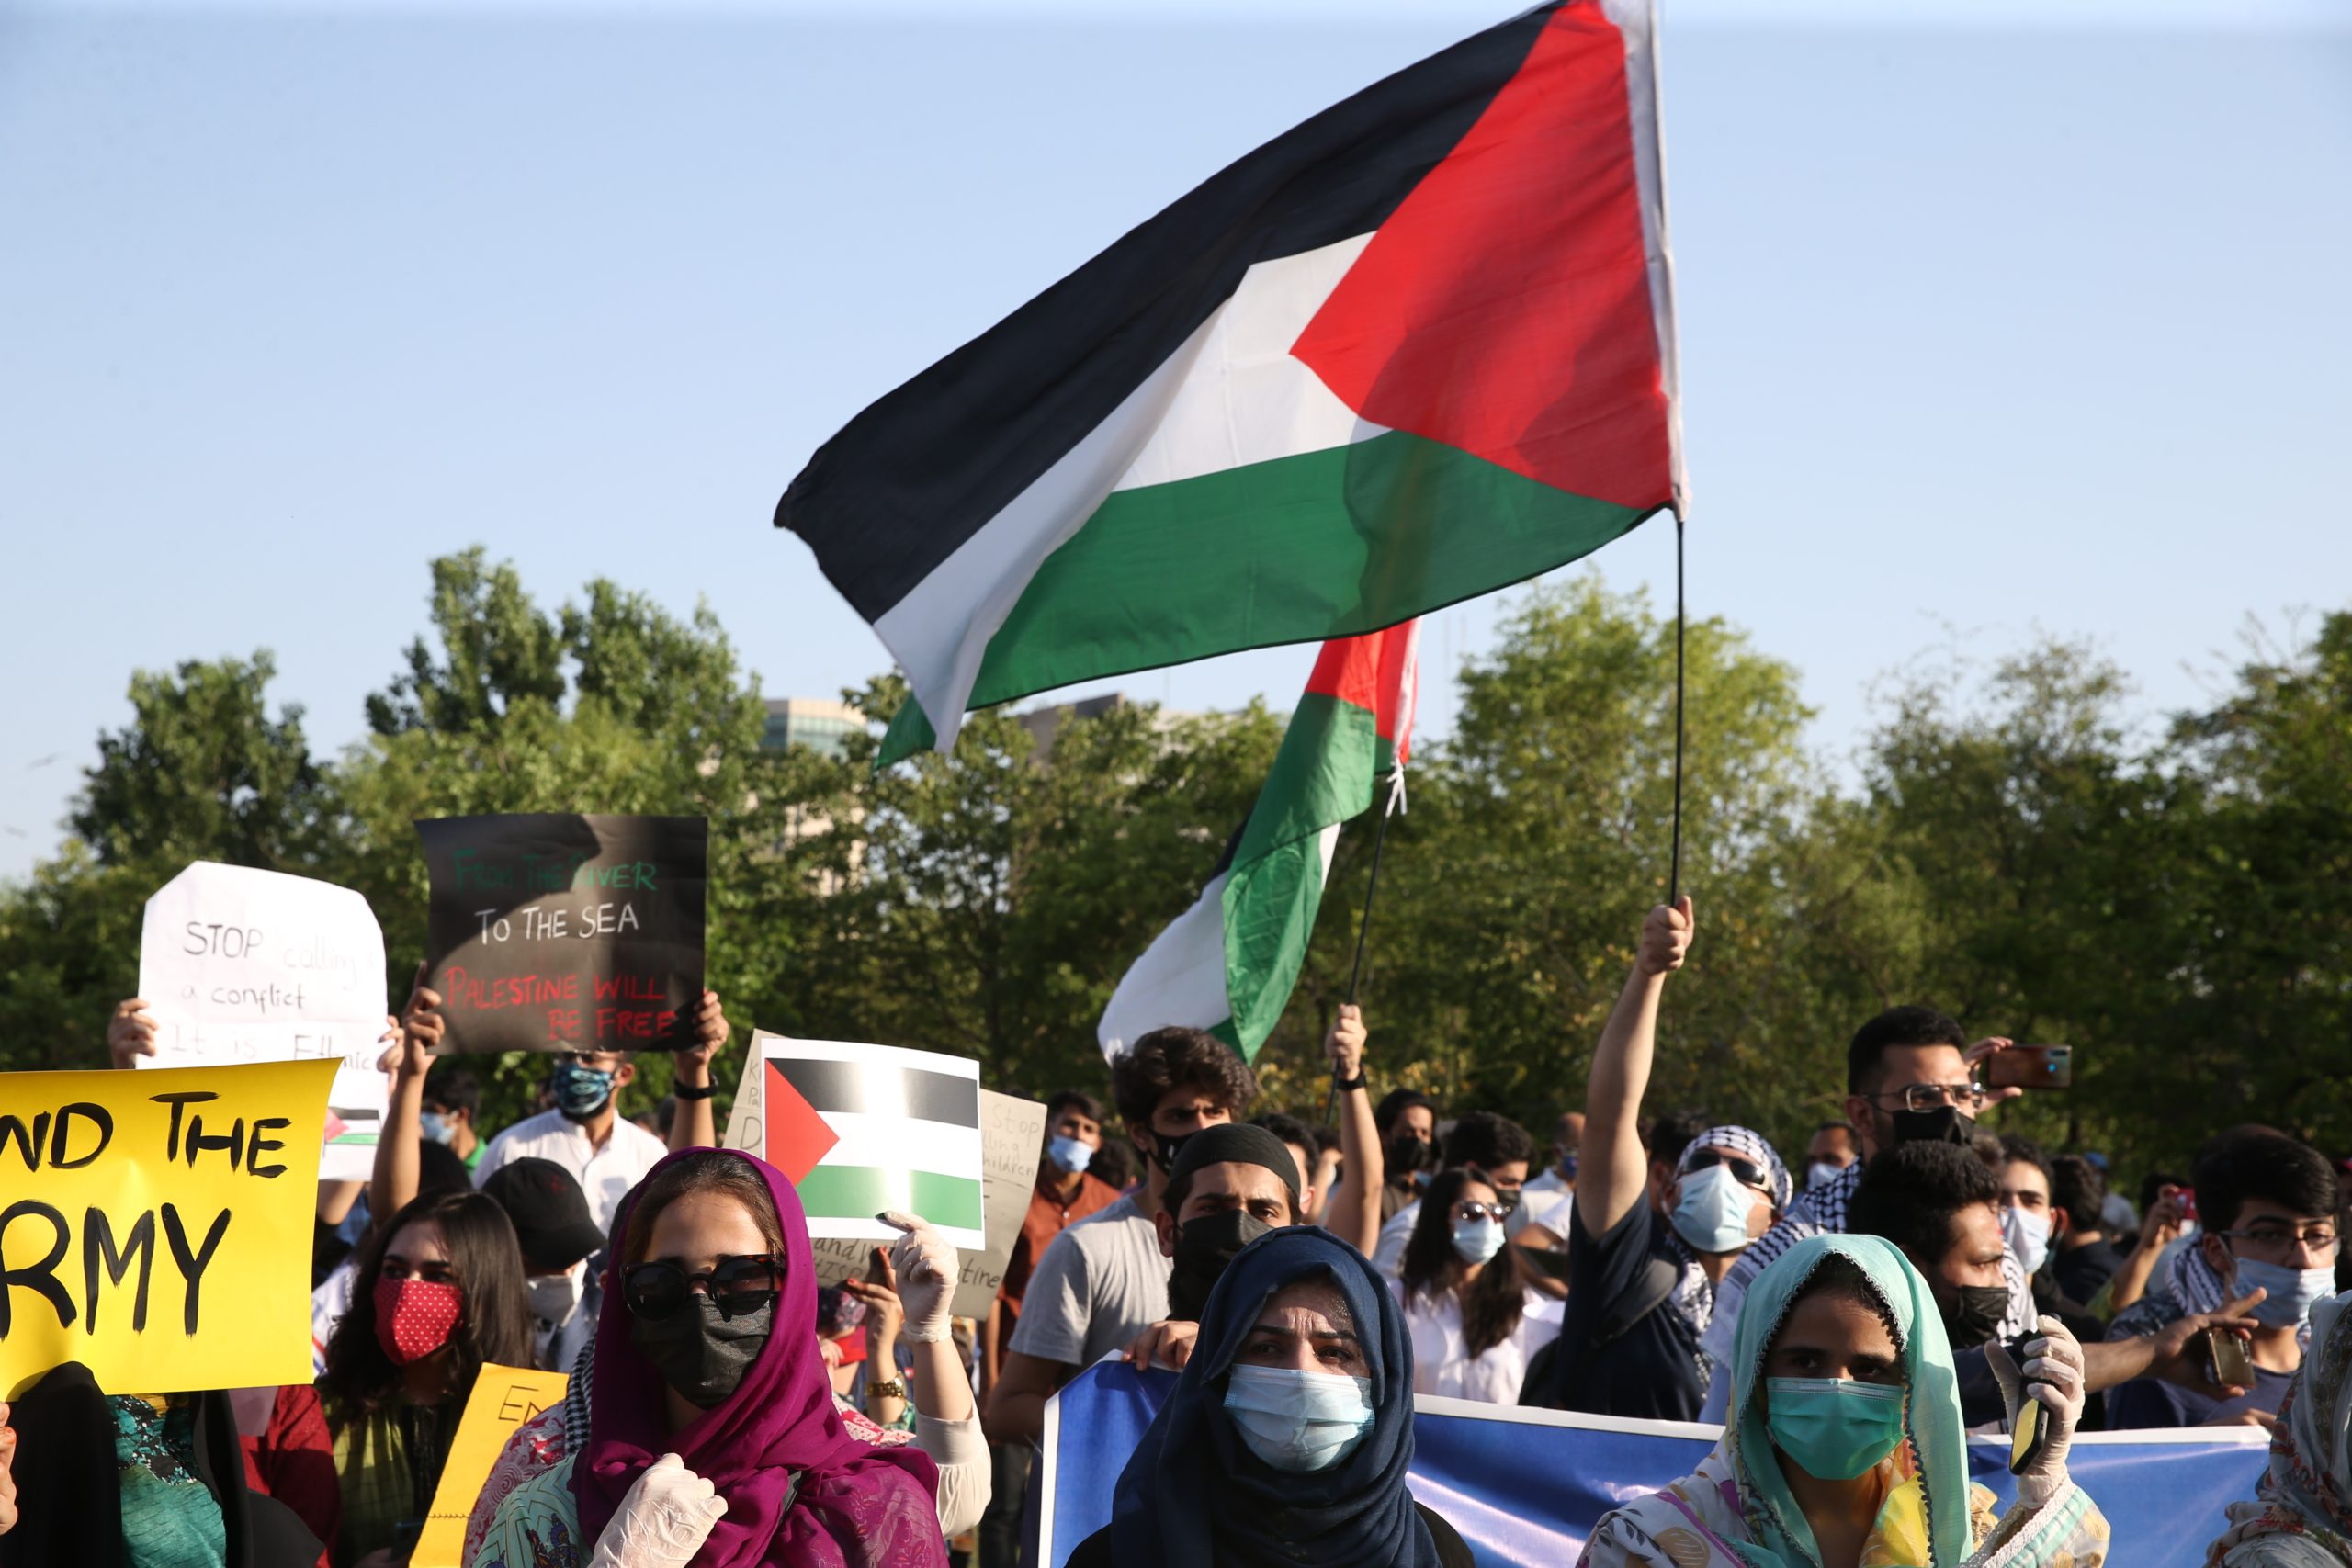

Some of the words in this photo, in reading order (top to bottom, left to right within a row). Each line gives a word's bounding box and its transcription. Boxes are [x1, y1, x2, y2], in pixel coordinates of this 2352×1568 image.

[183, 921, 264, 958] STOP
[475, 909, 510, 944] TO
[523, 908, 567, 940] THE
[579, 904, 639, 938] SEA
[211, 983, 305, 1013] conflict
[444, 967, 578, 1010] PALESTINE
[594, 975, 664, 1000] WILL
[548, 1008, 580, 1041] BE
[598, 1008, 677, 1037] FREE
[0, 1102, 113, 1172] ND
[149, 1091, 291, 1178] THE
[993, 1104, 1040, 1148] Stop
[983, 1155, 1035, 1177] hildren
[815, 1238, 860, 1260] and
[0, 1200, 232, 1341] RMY
[958, 1258, 1001, 1288] tine
